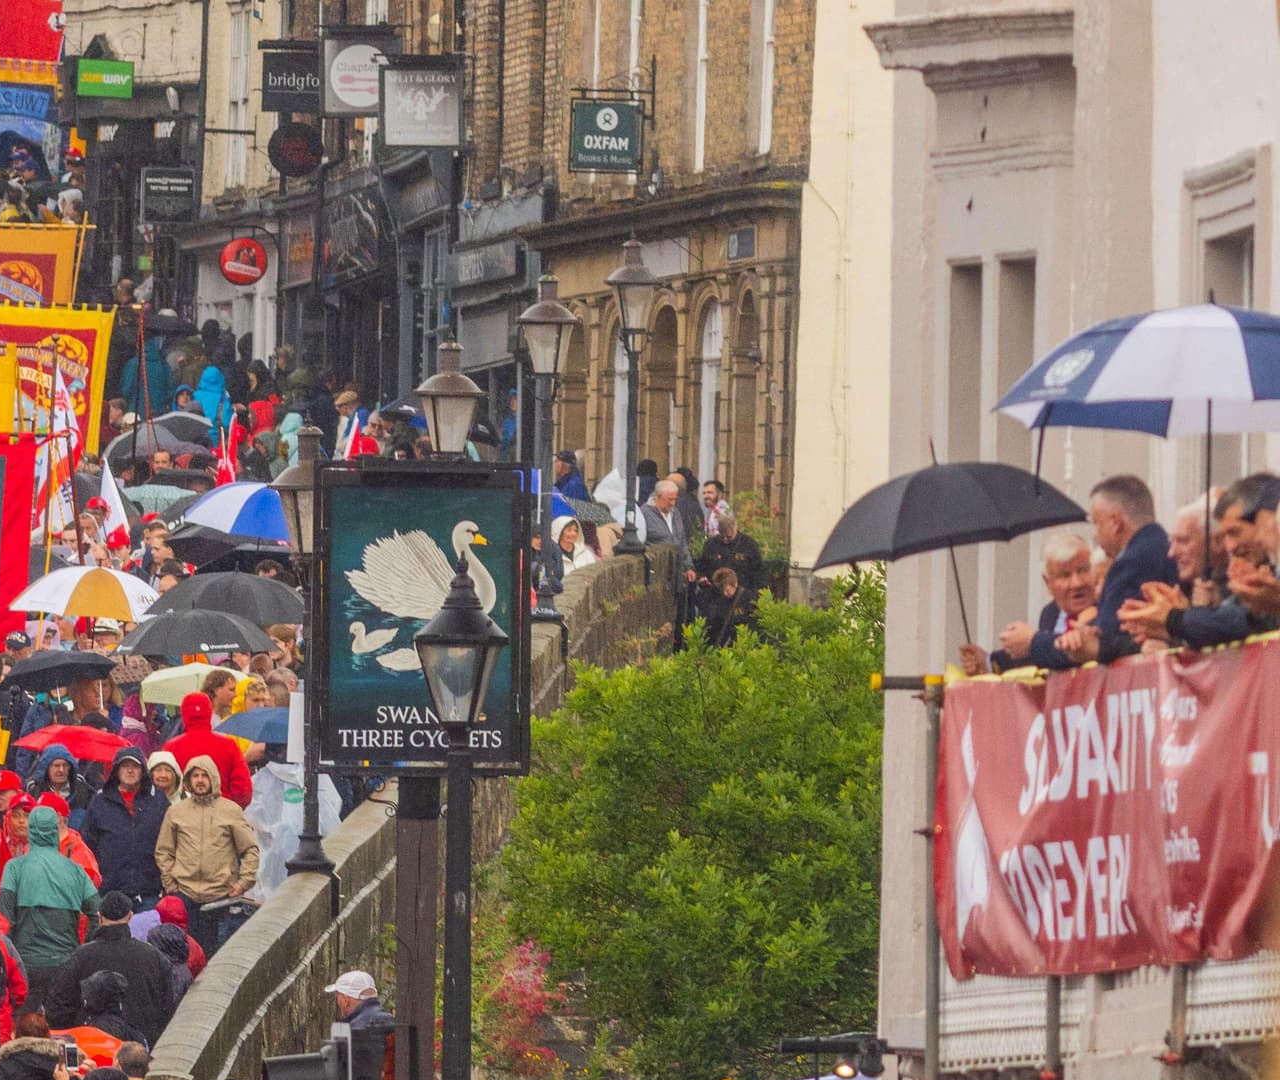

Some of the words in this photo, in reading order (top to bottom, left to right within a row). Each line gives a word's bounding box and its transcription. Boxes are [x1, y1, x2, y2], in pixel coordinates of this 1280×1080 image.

[81, 73, 132, 85] SUBWAY
[268, 71, 319, 92] bridgfo
[584, 135, 629, 150] OXFAM
[578, 153, 602, 163] Books
[610, 154, 632, 165] Music
[376, 706, 439, 724] SWAN
[339, 729, 403, 748] THREE
[409, 729, 502, 748] CYGETS
